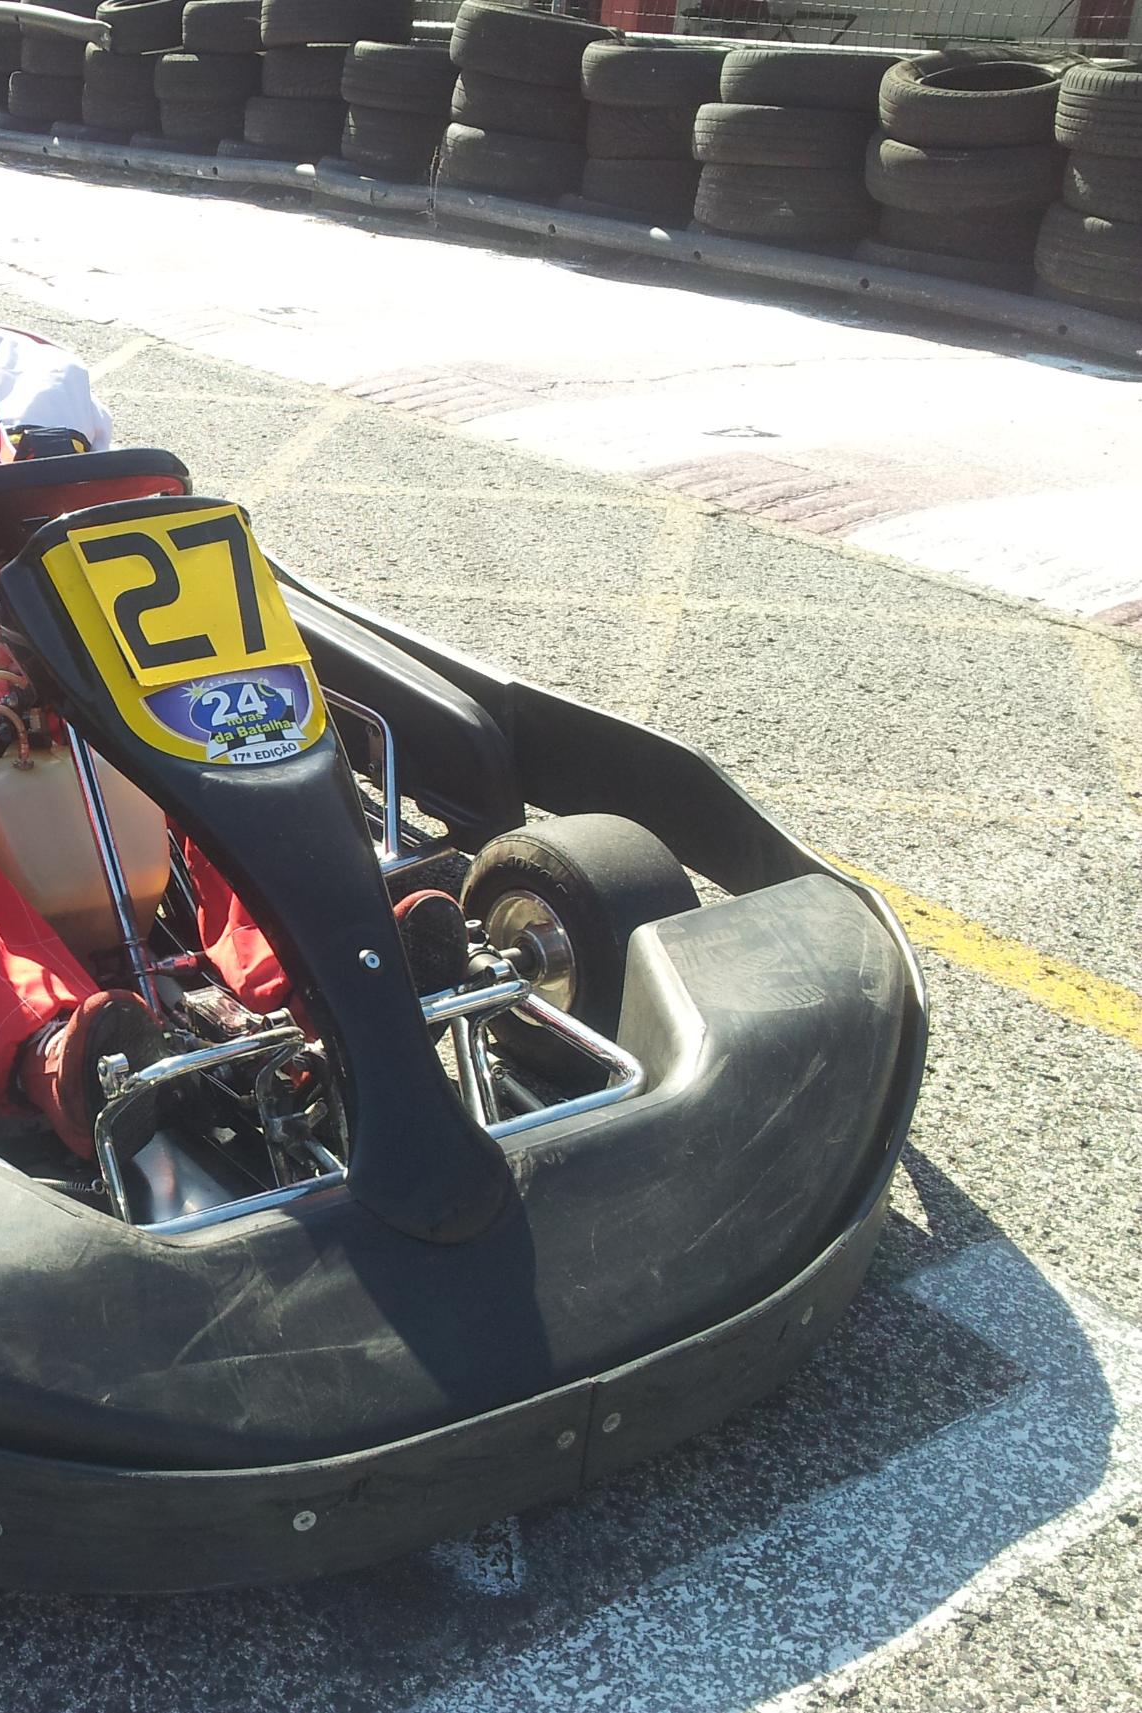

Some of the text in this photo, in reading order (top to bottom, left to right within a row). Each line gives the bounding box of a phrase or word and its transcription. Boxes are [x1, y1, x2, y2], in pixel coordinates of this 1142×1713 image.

[79, 513, 267, 670] 27
[201, 684, 268, 726] 24
[214, 719, 291, 744] da Batalha
[254, 743, 297, 760] EDIÇÃO
